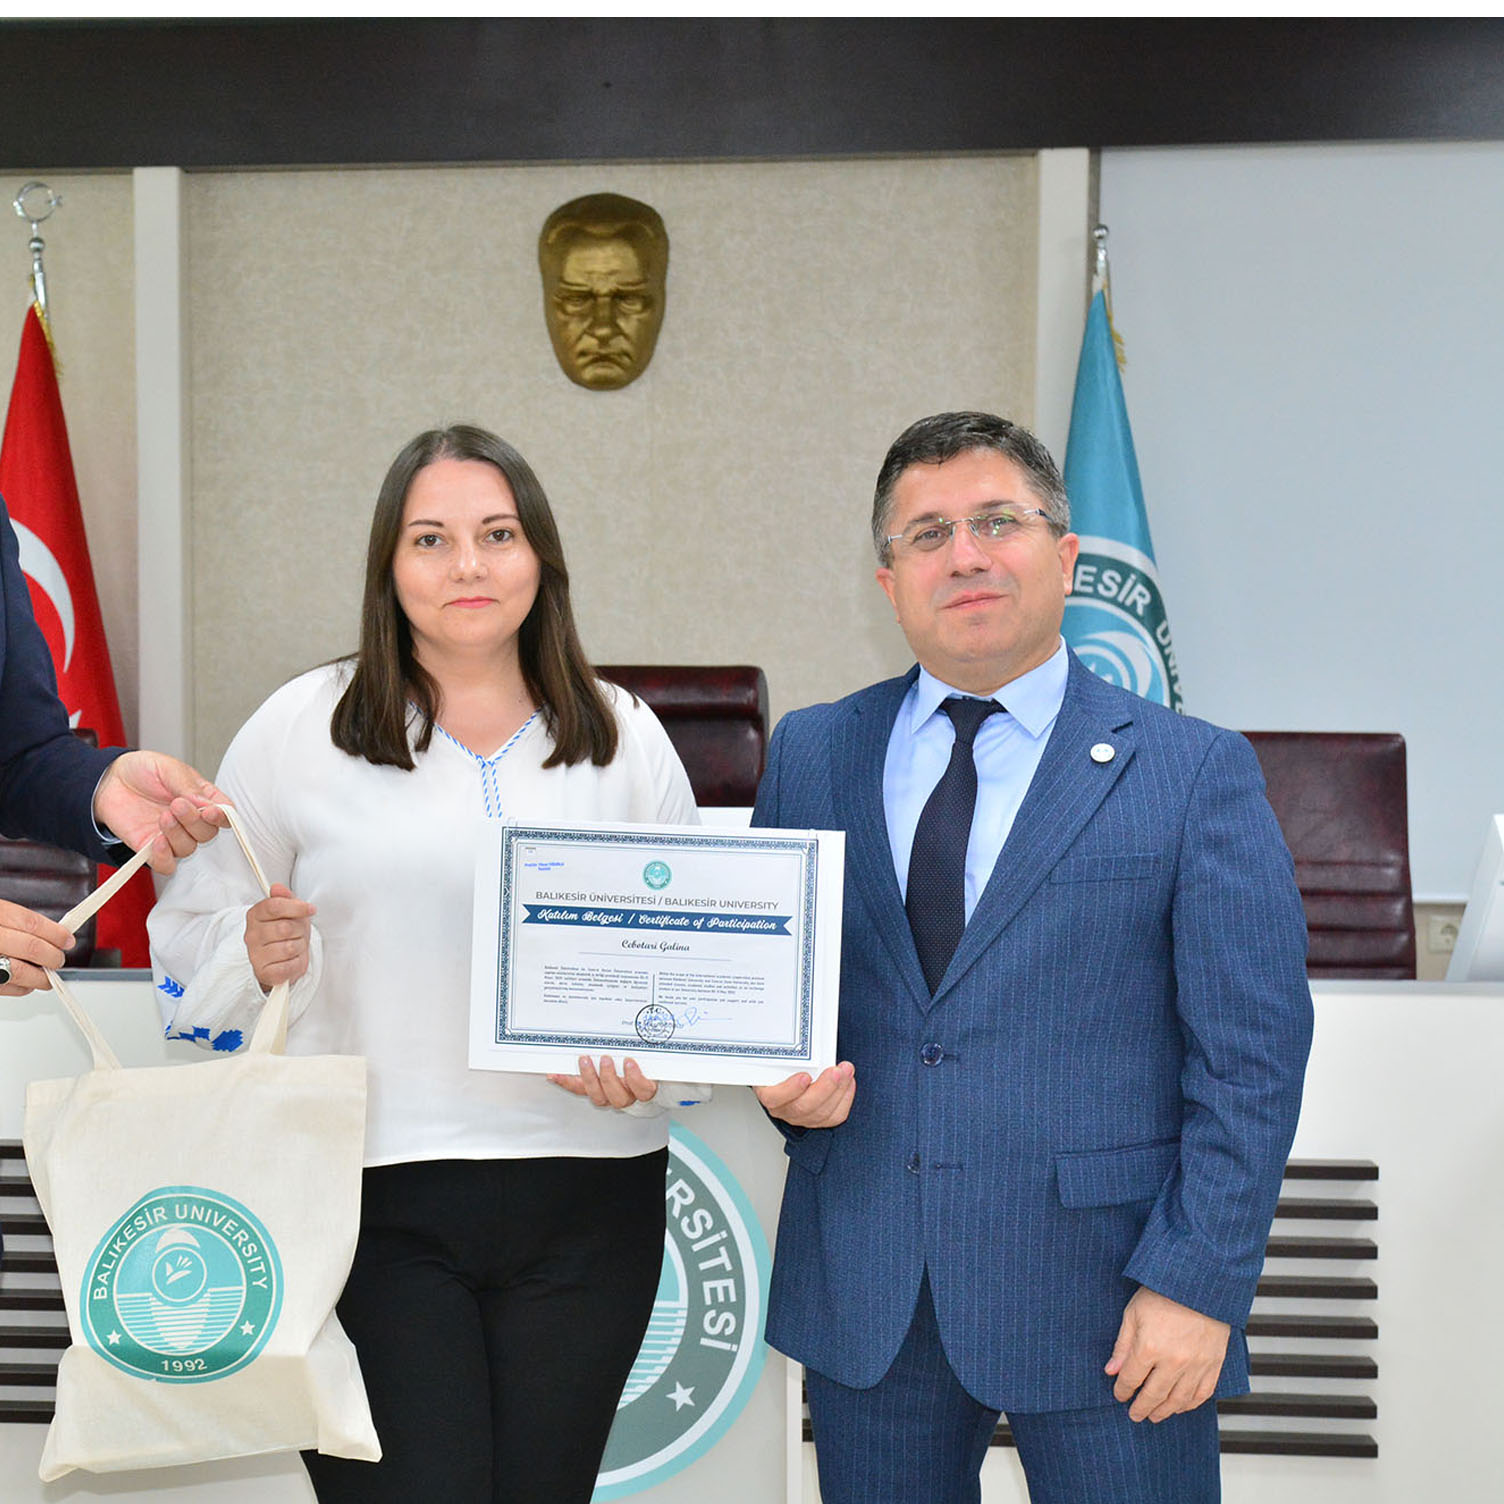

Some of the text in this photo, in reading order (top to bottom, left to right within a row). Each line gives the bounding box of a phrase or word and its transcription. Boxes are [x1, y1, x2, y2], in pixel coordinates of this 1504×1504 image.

[719, 899, 779, 911] UNIVERSITY
[581, 911, 624, 926] Belgesi
[638, 913, 690, 928] Certificate
[692, 917, 704, 929] of
[706, 917, 777, 931] Participation
[92, 1204, 268, 1301] BALIKESİR UNIVERSITY
[666, 1167, 739, 1353] RSİTESİ
[161, 1358, 208, 1373] 1992
